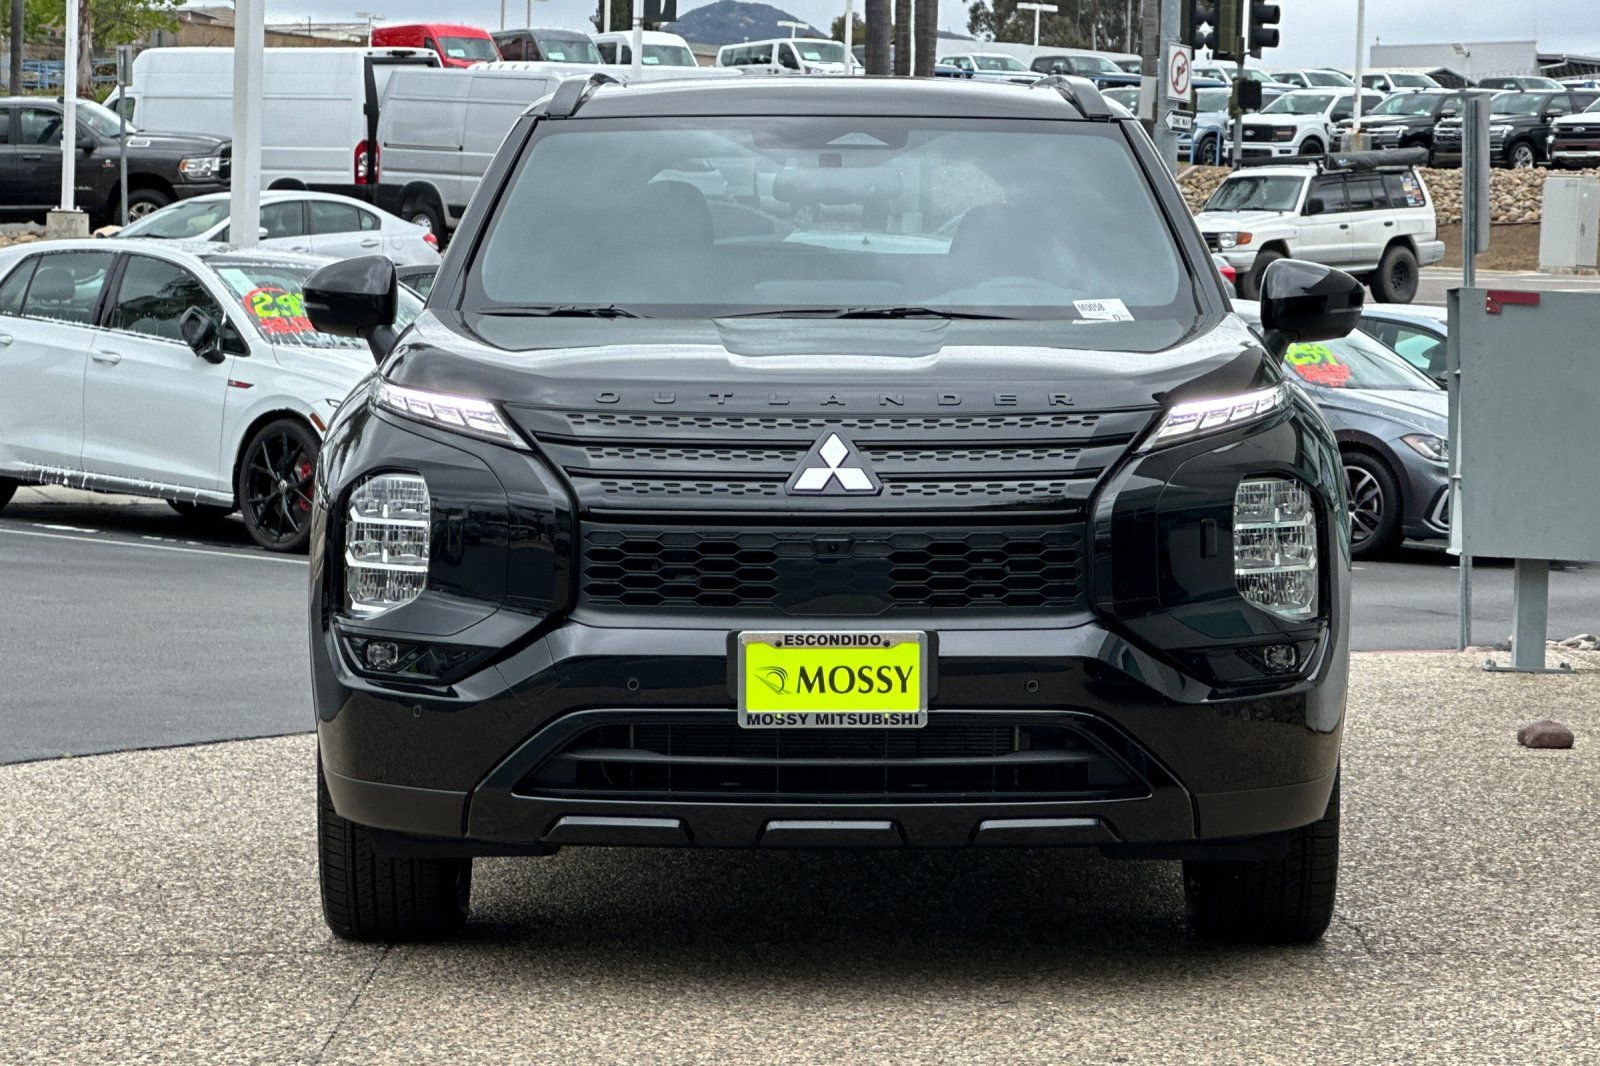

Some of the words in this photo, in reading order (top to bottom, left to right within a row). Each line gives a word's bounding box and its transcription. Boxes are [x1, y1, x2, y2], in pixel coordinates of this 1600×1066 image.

[595, 392, 1075, 405] OUTLANDER
[784, 634, 882, 646] ESCONDIDO
[796, 665, 914, 694] MOSSY
[746, 713, 809, 726] MOSSY
[815, 713, 919, 726] MITSUBISHI
